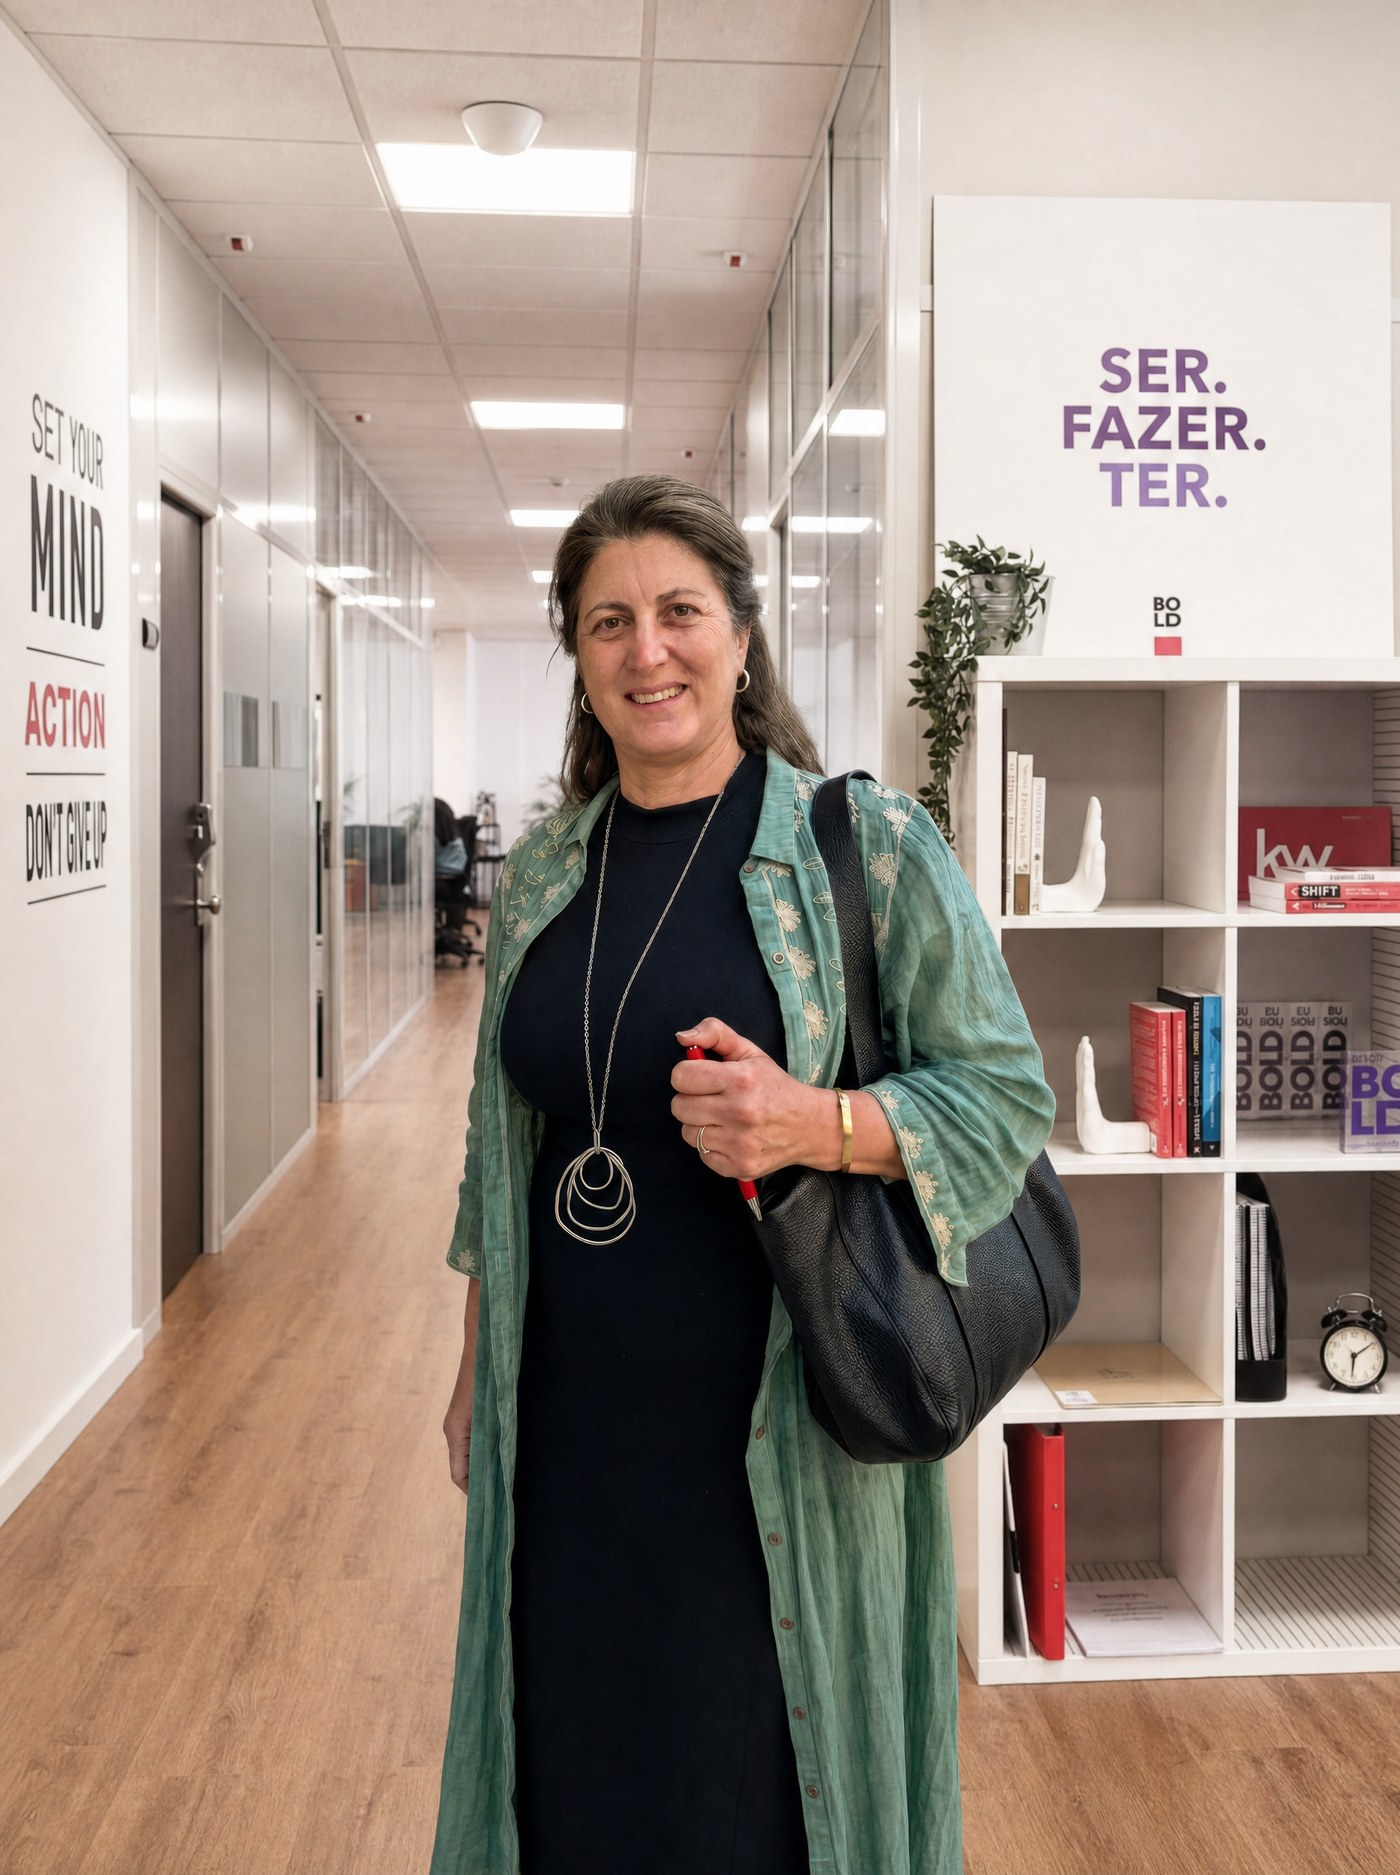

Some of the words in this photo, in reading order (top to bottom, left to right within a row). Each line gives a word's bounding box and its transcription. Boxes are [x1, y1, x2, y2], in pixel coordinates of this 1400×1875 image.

[1099, 347, 1227, 394] SER.
[31, 393, 65, 466] SET
[68, 415, 104, 490] YOUR
[1063, 405, 1267, 451] FAZER.
[1099, 462, 1228, 508] TER.
[30, 473, 104, 631] MIND
[25, 681, 106, 749] ACTION
[26, 803, 63, 882] DON'T
[66, 801, 91, 874] GIVE
[93, 800, 108, 869] UP
[1256, 828, 1334, 879] kw
[1301, 885, 1339, 897] SHIFT
[1259, 1030, 1284, 1111] BOLD
[1290, 1030, 1315, 1110] BOLD
